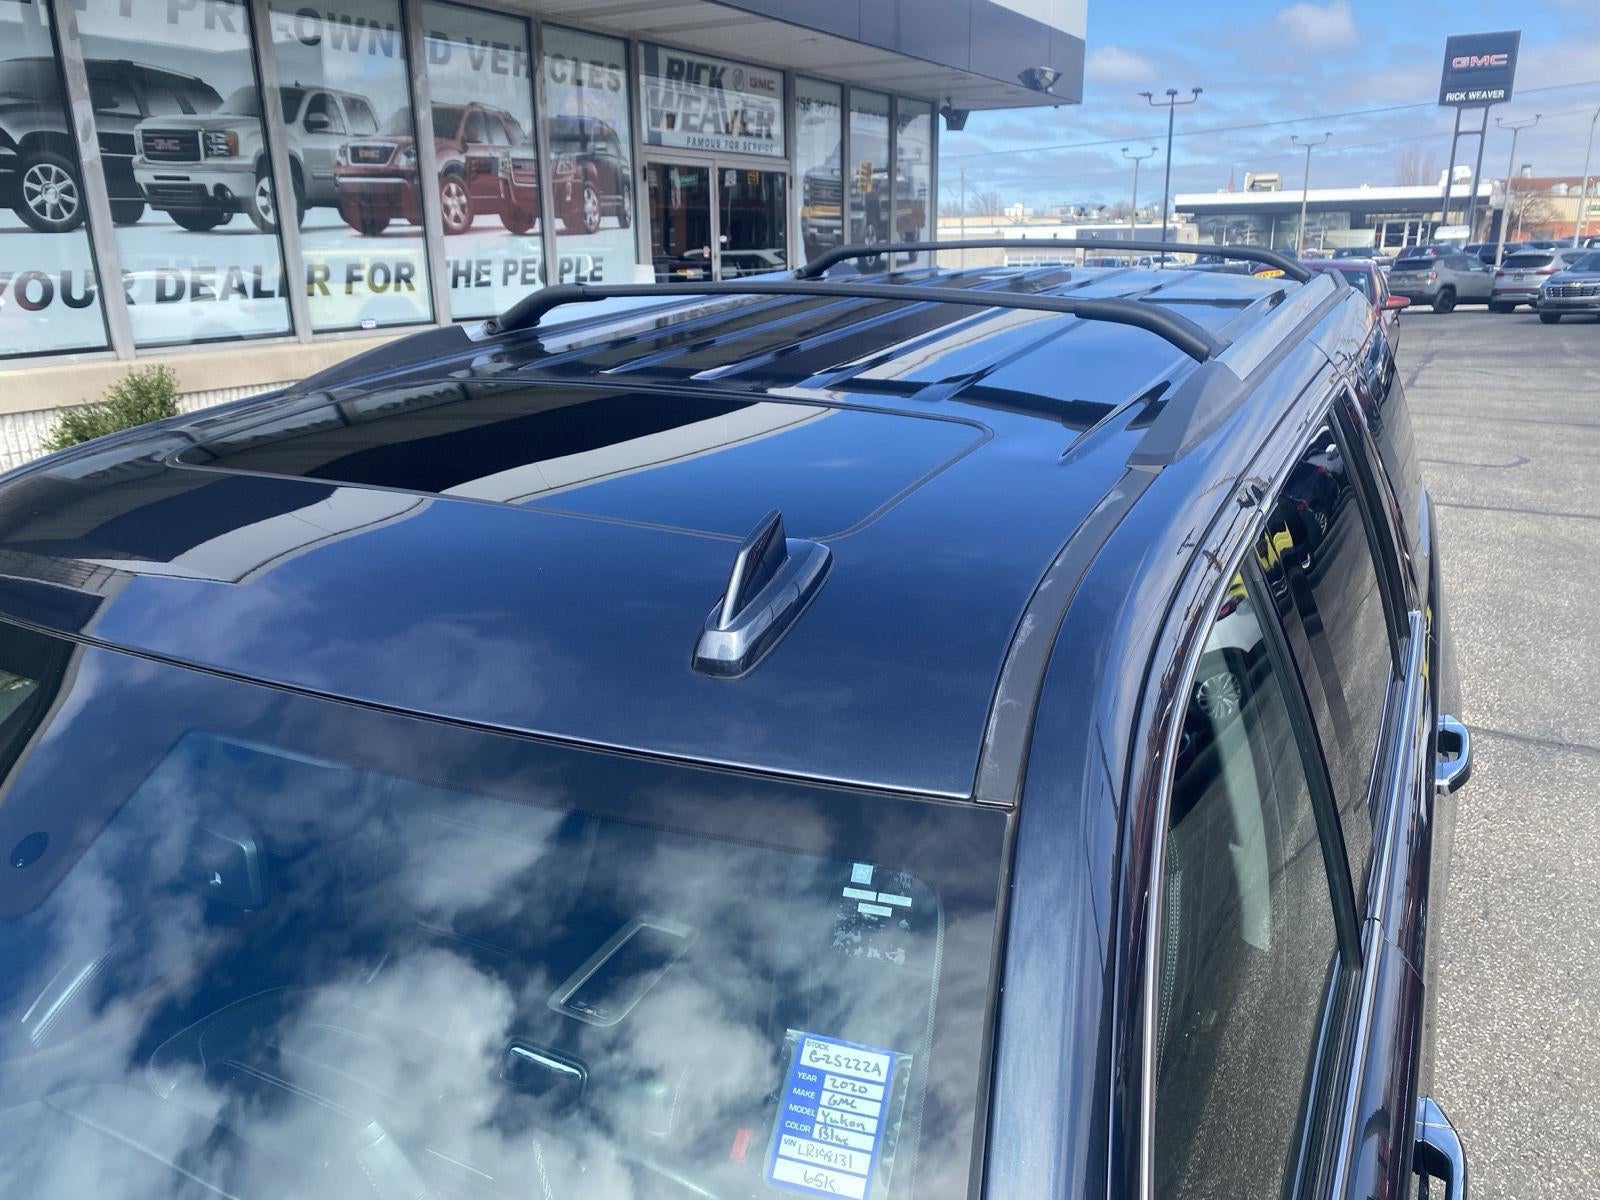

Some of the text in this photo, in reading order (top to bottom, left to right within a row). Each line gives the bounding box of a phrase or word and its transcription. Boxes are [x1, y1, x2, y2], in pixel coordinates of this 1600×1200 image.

[464, 36, 621, 92] VEHCLES
[1452, 53, 1508, 68] GMC
[665, 58, 728, 91] RICK
[749, 76, 776, 91] GMC
[1446, 90, 1504, 102] RICK WEAVER
[686, 135, 721, 149] FAMOUS
[724, 139, 739, 149] FOR
[345, 260, 416, 295] FOR
[447, 258, 492, 289] HE
[805, 1041, 830, 1051] STOCK
[797, 1071, 868, 1094] YEAR 2020
[792, 1087, 816, 1099] MAKE
[788, 1103, 866, 1131] MODEL Yukon
[785, 1120, 811, 1133] COLOR
[783, 1138, 797, 1147] VIN
